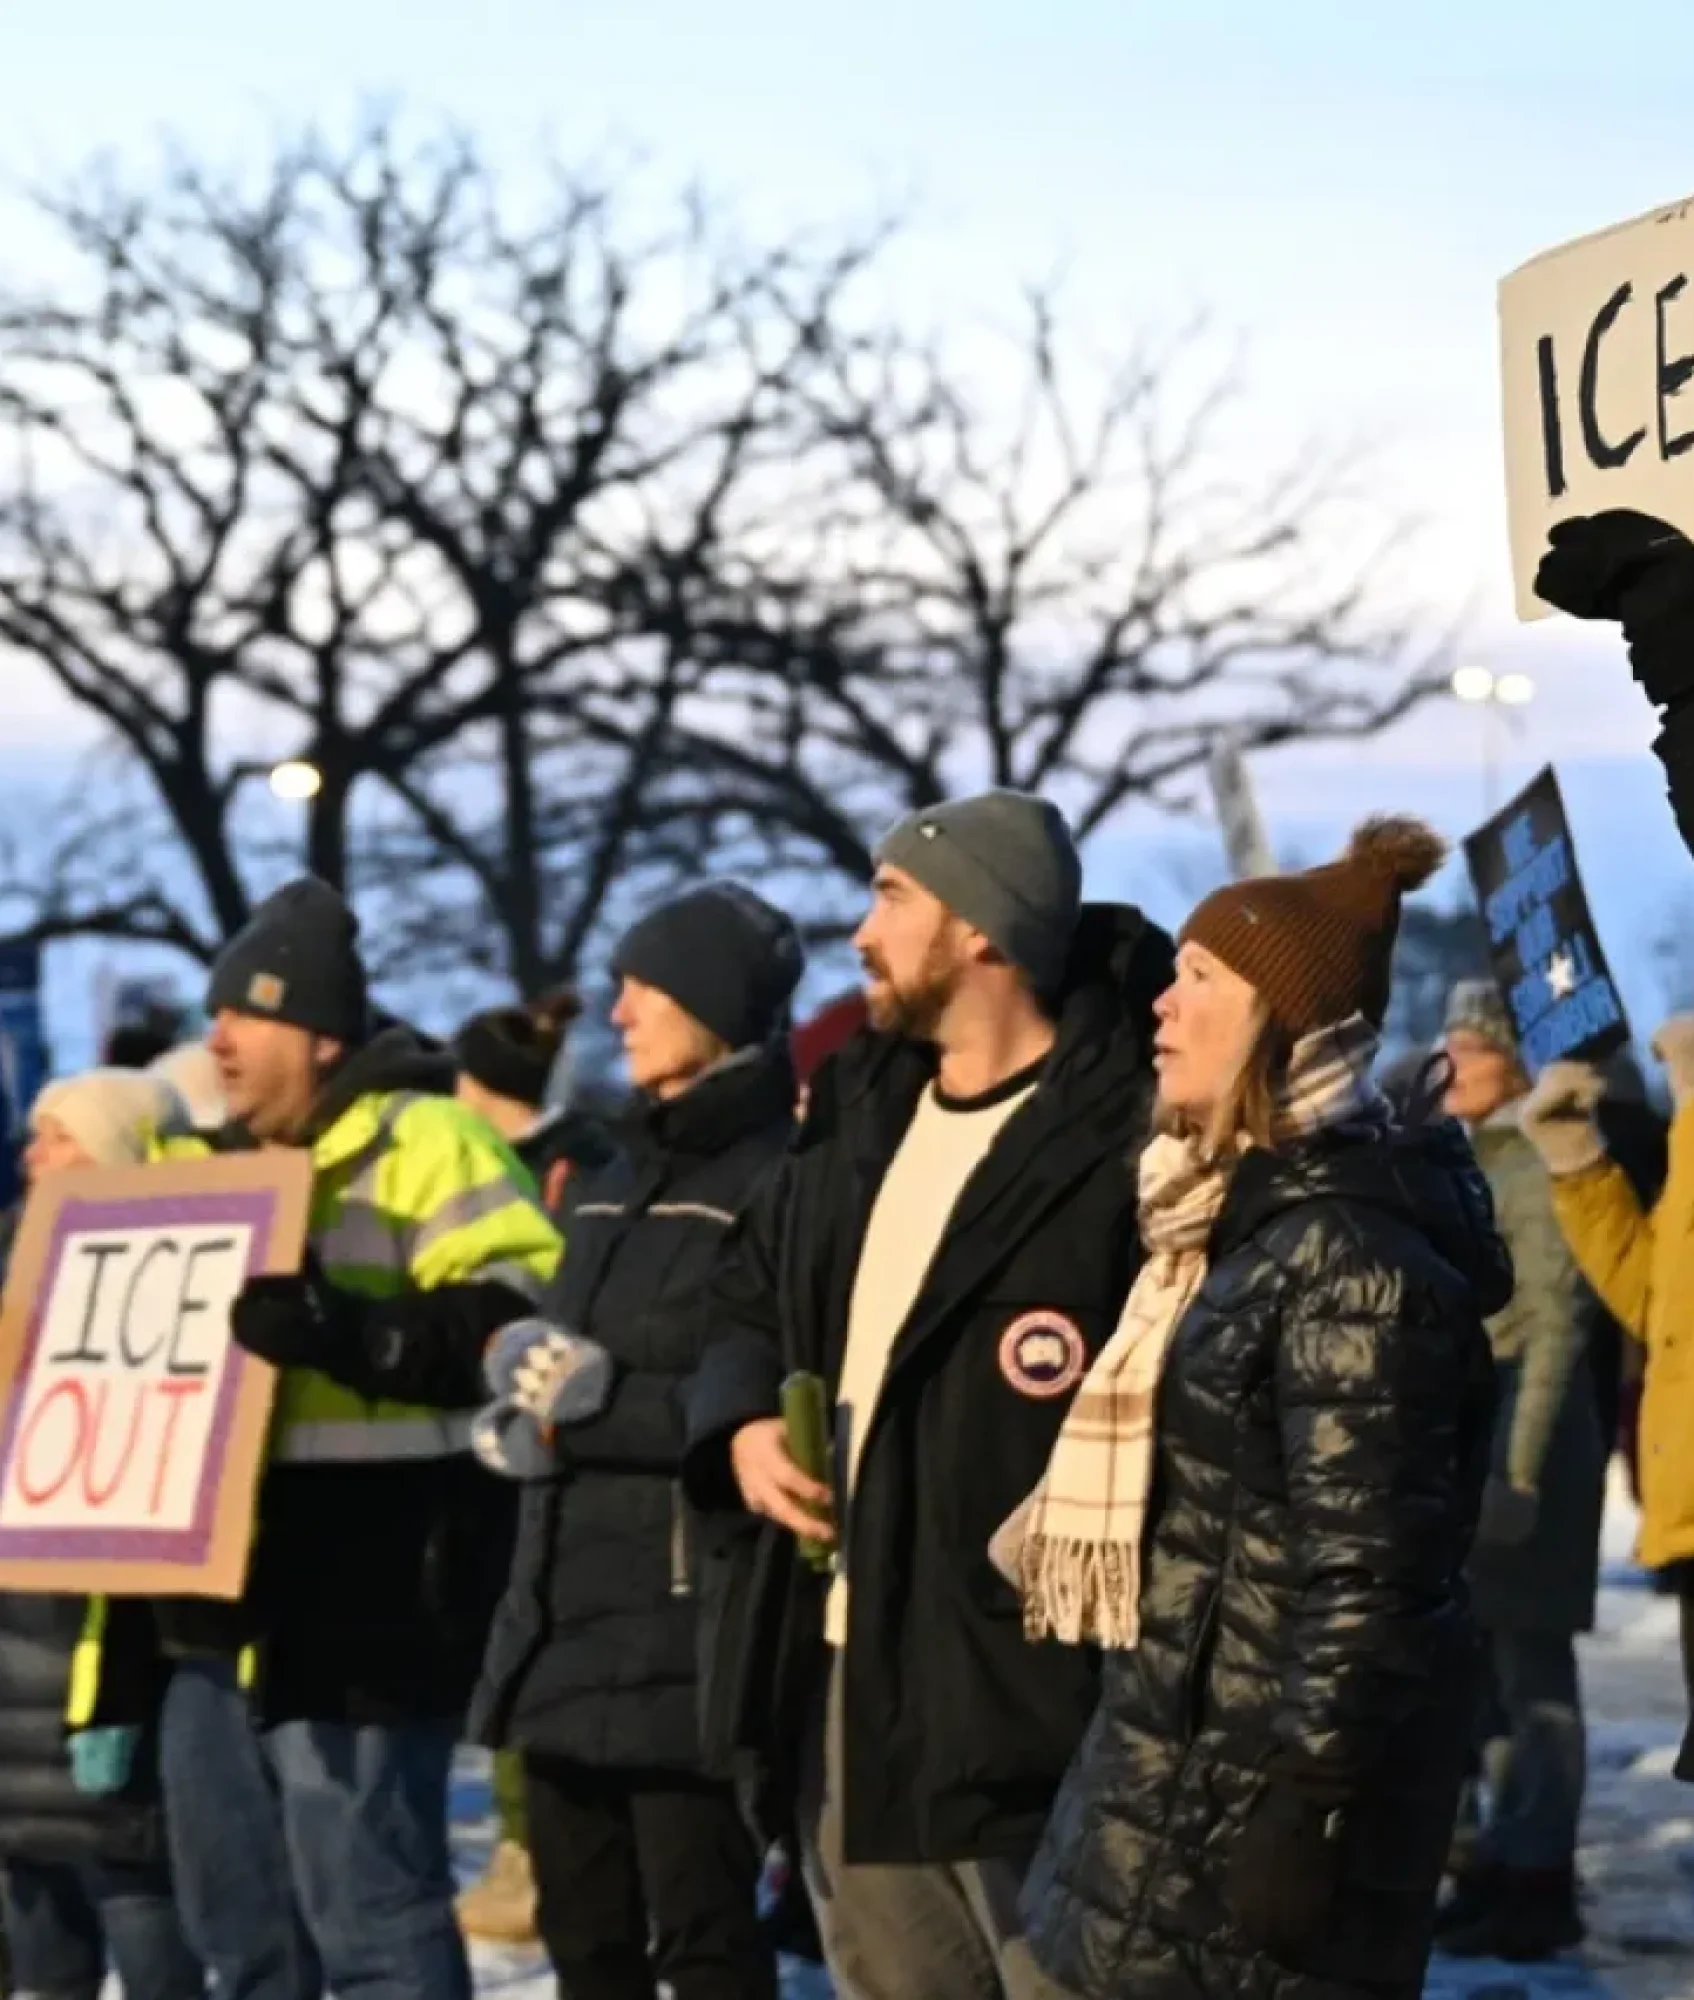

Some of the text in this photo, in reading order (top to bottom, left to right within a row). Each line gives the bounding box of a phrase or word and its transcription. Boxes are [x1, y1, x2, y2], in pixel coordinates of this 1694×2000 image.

[1538, 272, 1694, 497] ICE
[50, 1238, 235, 1374] ICE
[15, 1378, 206, 1515] OUT
